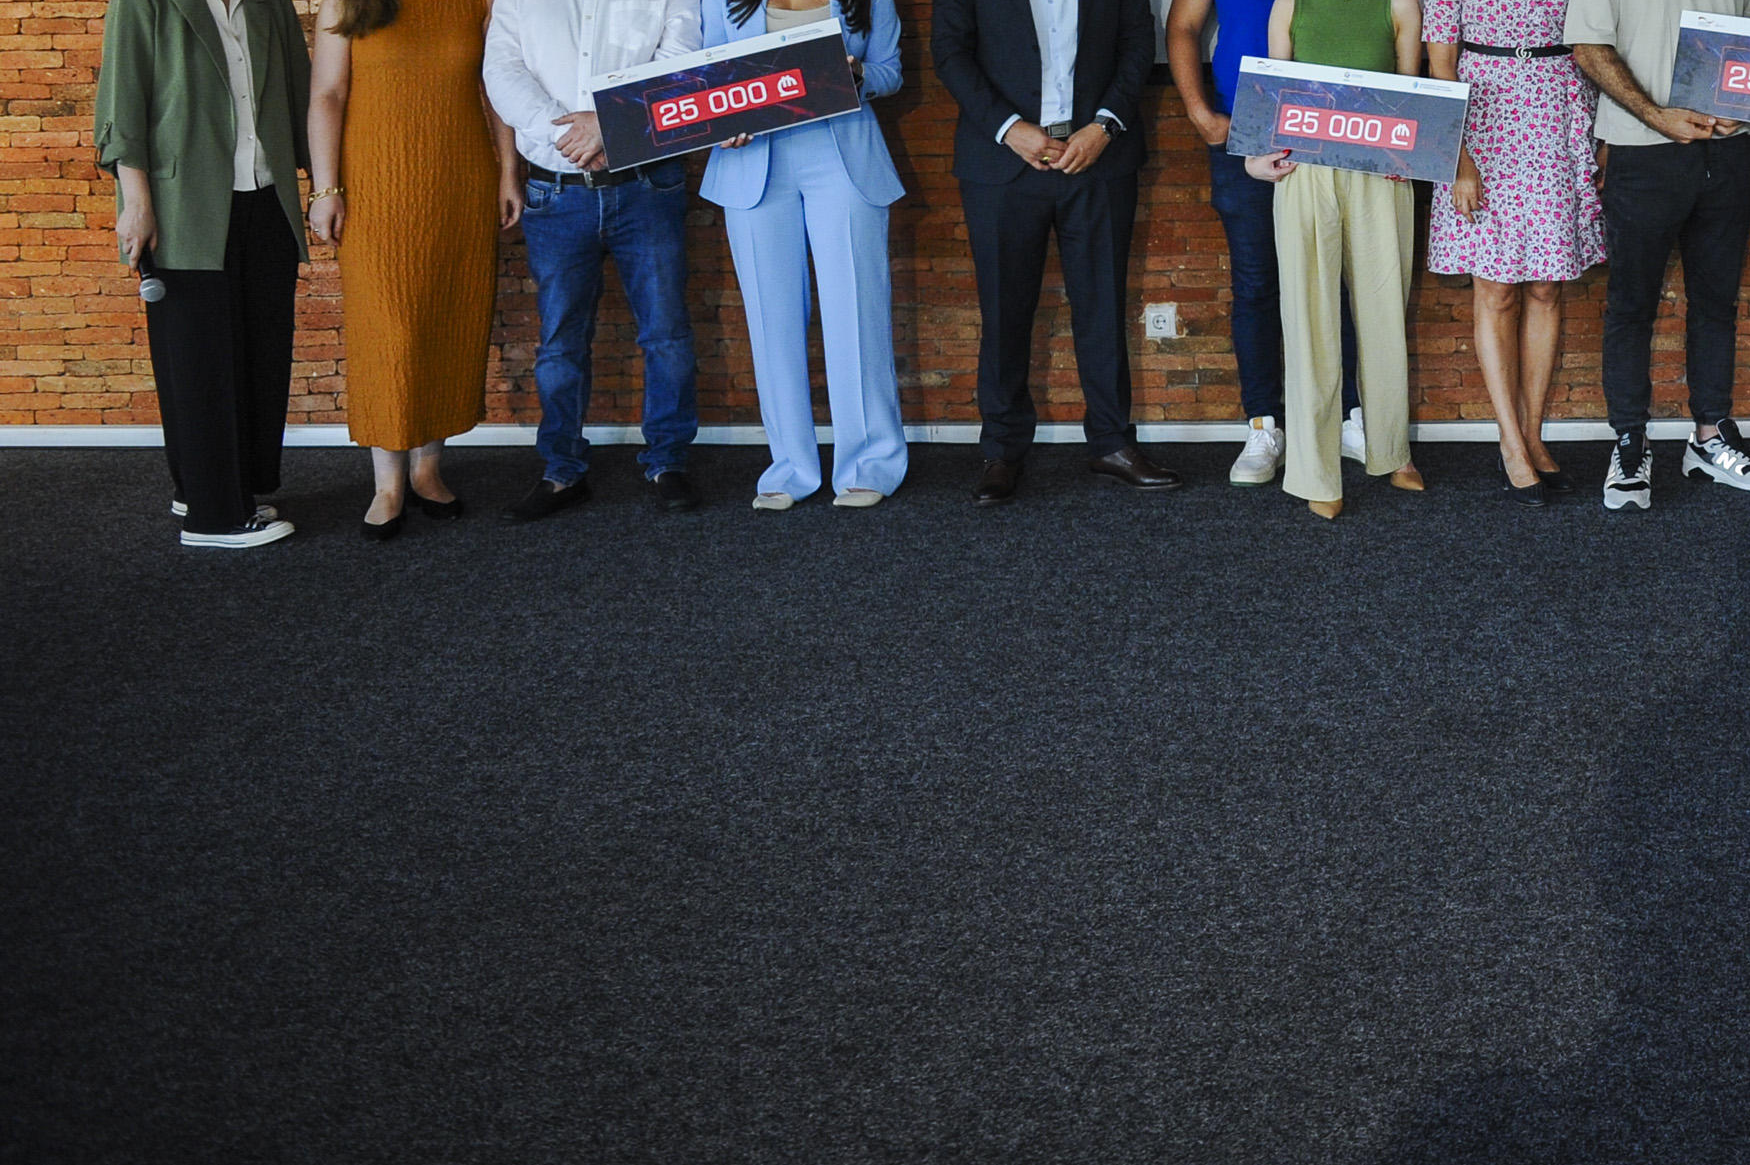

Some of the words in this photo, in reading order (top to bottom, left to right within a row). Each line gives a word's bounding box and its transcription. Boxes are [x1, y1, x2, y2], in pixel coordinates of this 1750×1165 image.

[658, 98, 699, 126] 25
[708, 81, 767, 114] 000
[1284, 109, 1320, 134] 25
[1329, 114, 1382, 142] 000
